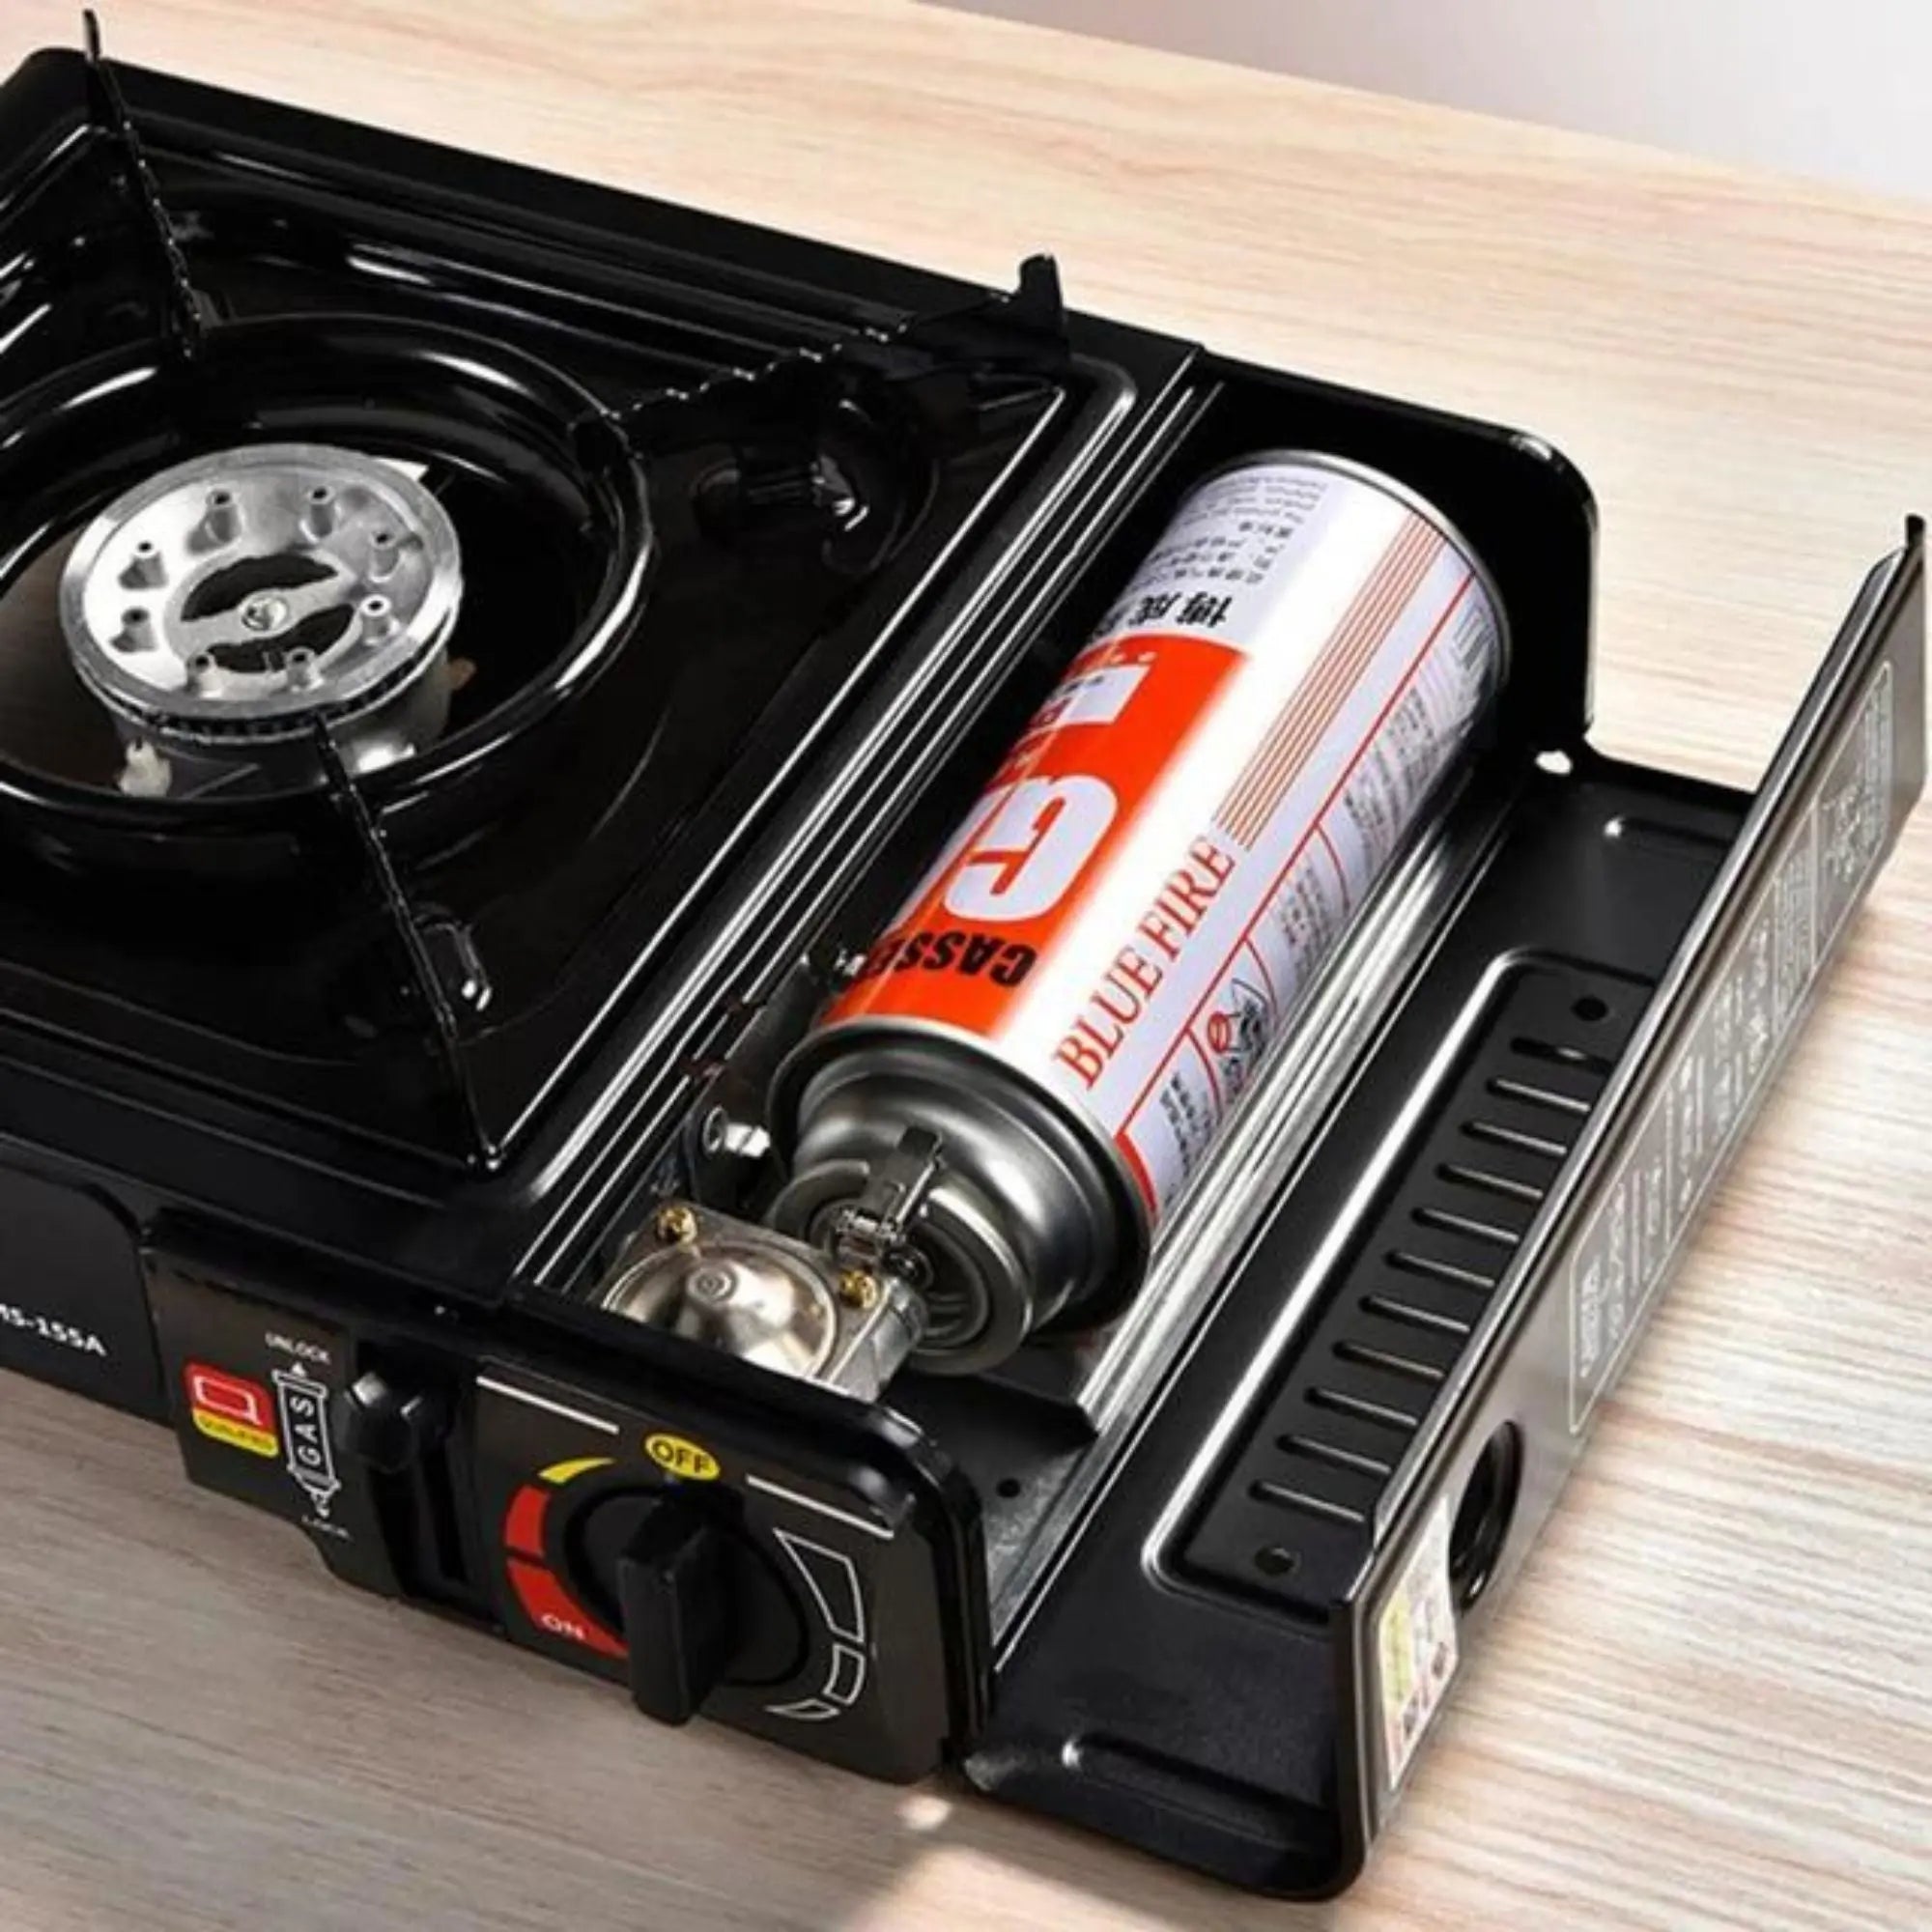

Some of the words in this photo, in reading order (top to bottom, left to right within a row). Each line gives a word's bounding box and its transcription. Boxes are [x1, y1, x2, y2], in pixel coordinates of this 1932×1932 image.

[1052, 945, 1164, 1092] BLUE
[1136, 835, 1236, 963] FIRE
[290, 1396, 322, 1467] GAS
[650, 1437, 712, 1475] OFF
[541, 1612, 585, 1641] ON
